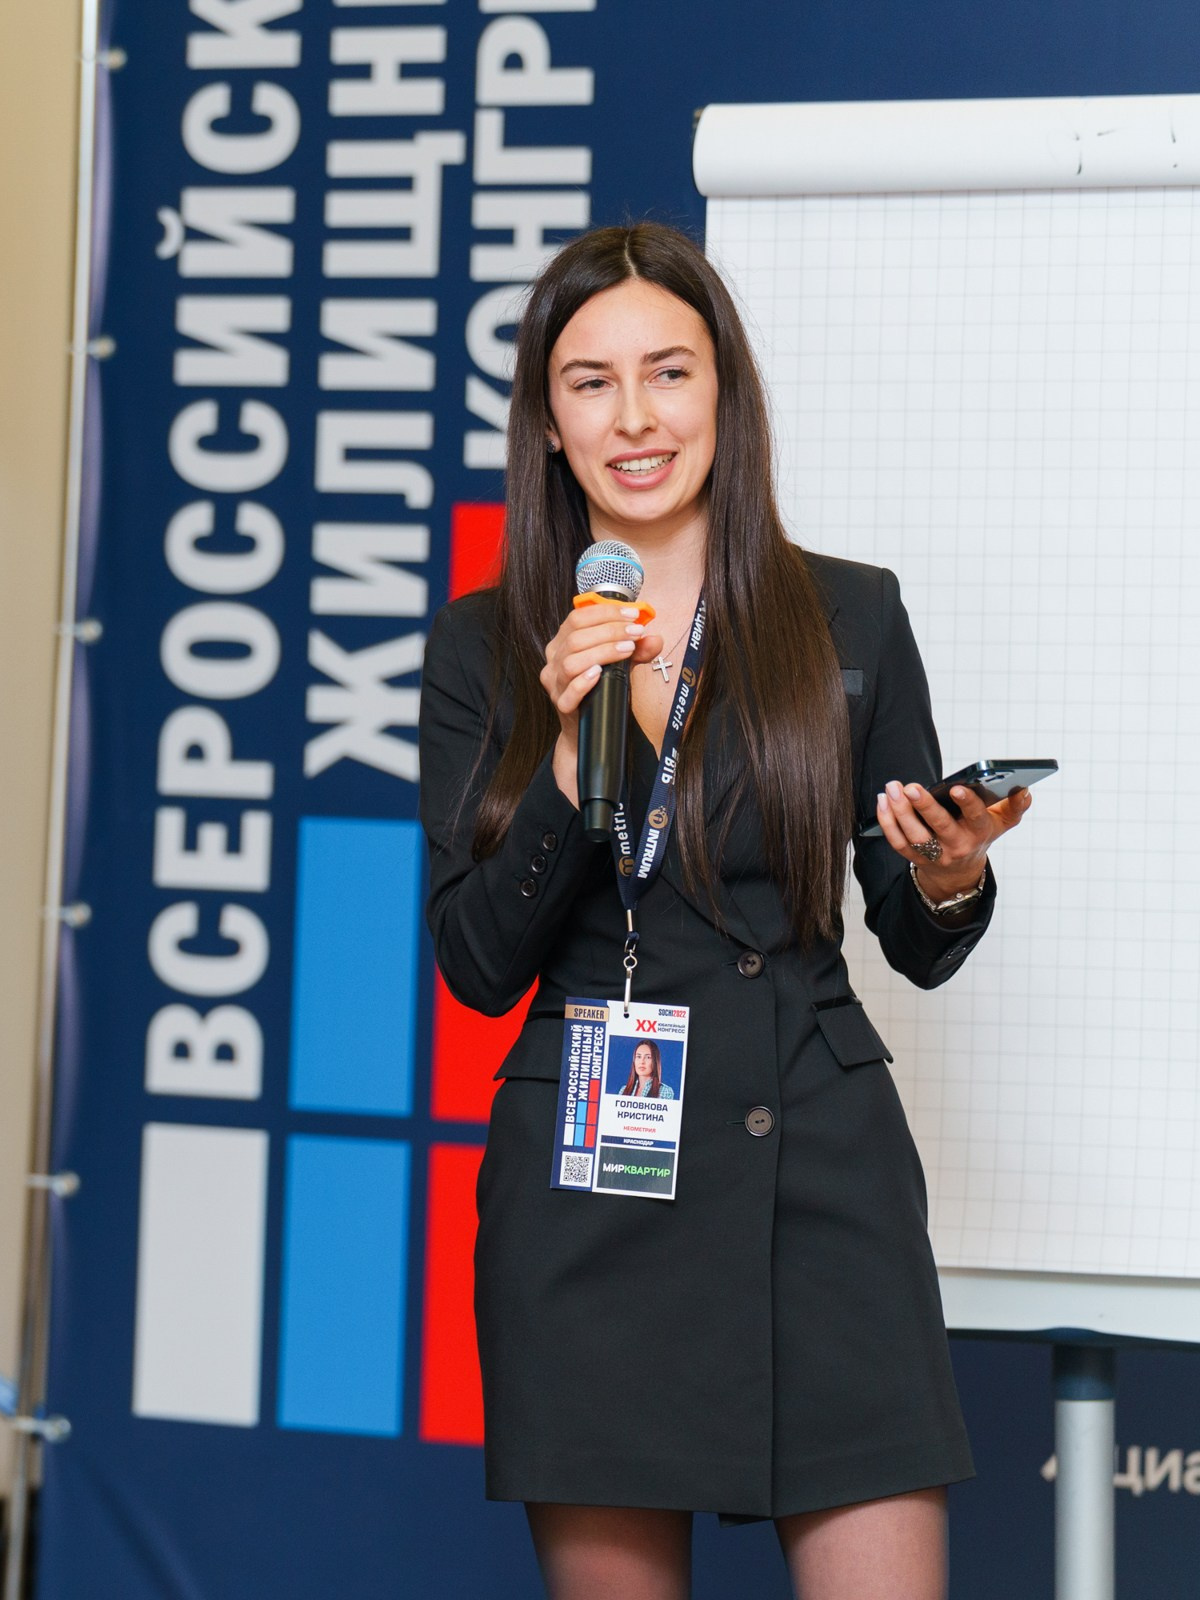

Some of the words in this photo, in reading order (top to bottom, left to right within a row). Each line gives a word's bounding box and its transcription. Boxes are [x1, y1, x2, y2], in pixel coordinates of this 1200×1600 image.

[303, 0, 466, 783] ЖИЛИЩН
[144, 0, 303, 1100] ВСЕРОССИЙСК
[637, 828, 660, 879] INTRUM
[574, 1007, 605, 1020] SPEAKER
[565, 1024, 583, 1123] ВСЕРОССИЙСКИЙ
[578, 1025, 593, 1101] ЖИЛИЩНЫЙ
[591, 1026, 604, 1079] КОНГРЕСС
[615, 1100, 668, 1112] ГОЛОВКОВА
[617, 1111, 664, 1122] КРИСТИНА
[602, 1162, 671, 1178] МИРКВАРТИР
